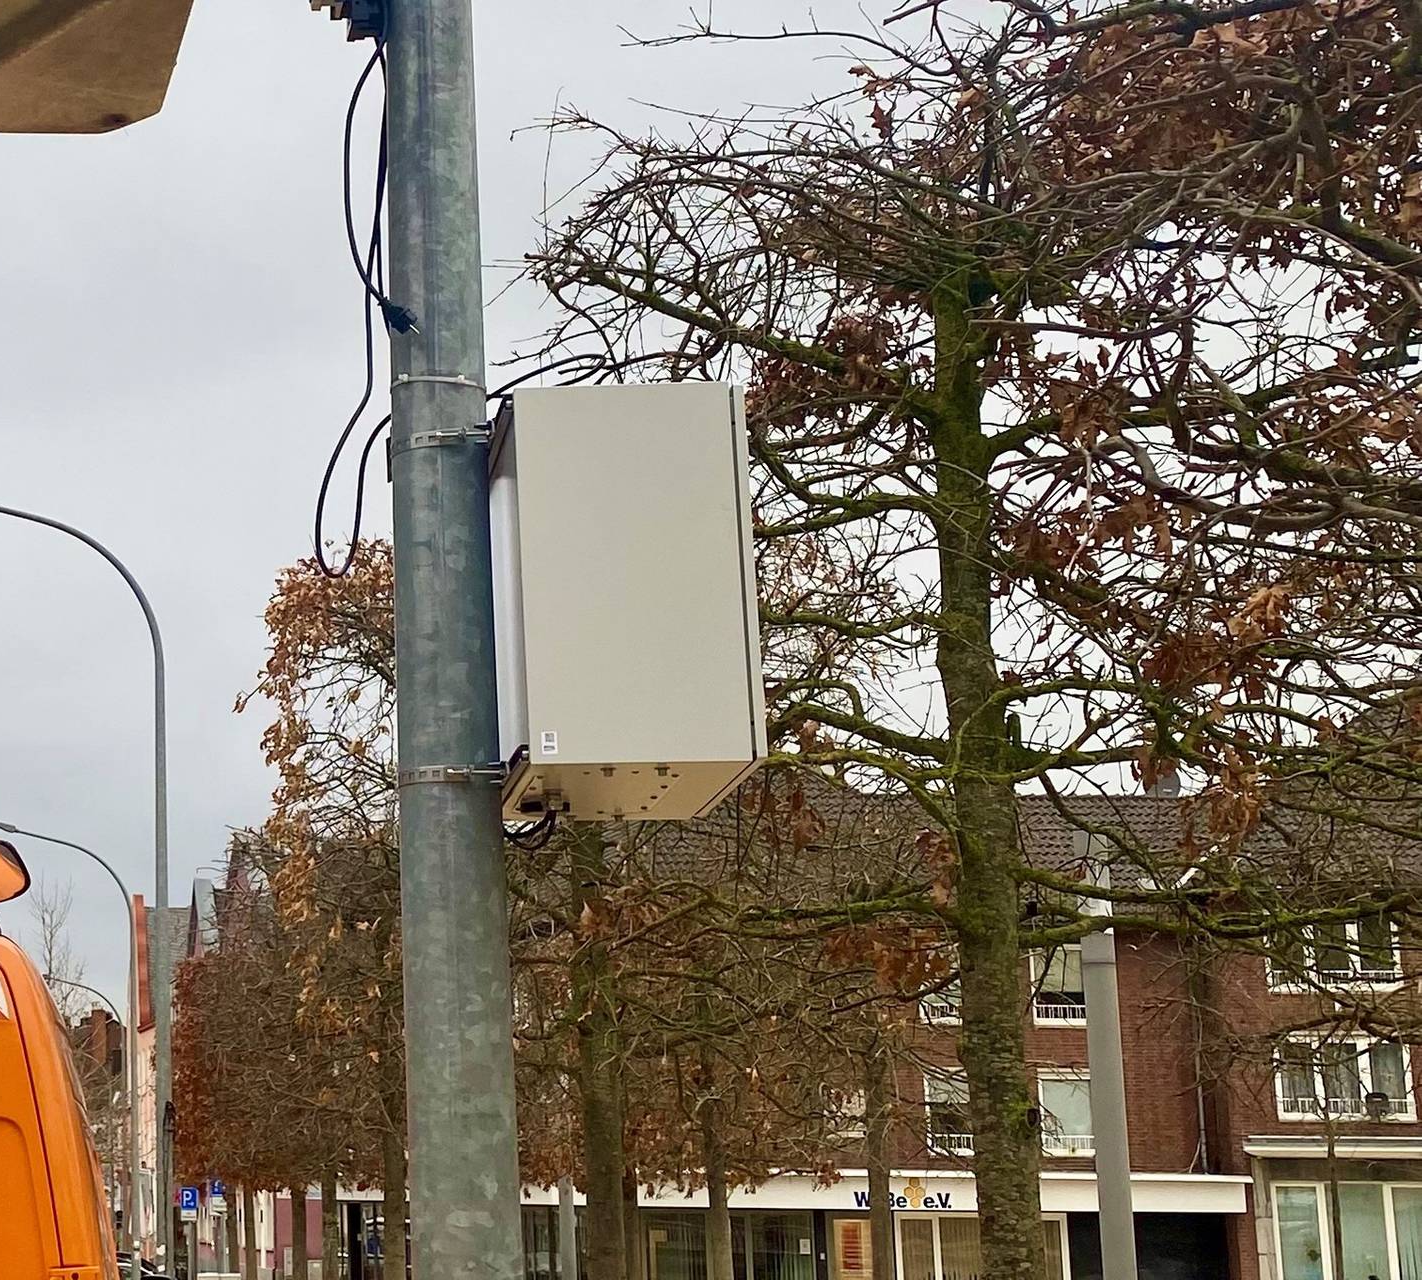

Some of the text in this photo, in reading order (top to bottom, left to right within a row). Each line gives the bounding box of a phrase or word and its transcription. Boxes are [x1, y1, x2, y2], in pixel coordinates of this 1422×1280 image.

[182, 1190, 193, 1207] P
[854, 1191, 952, 1209] WBe e.V.
